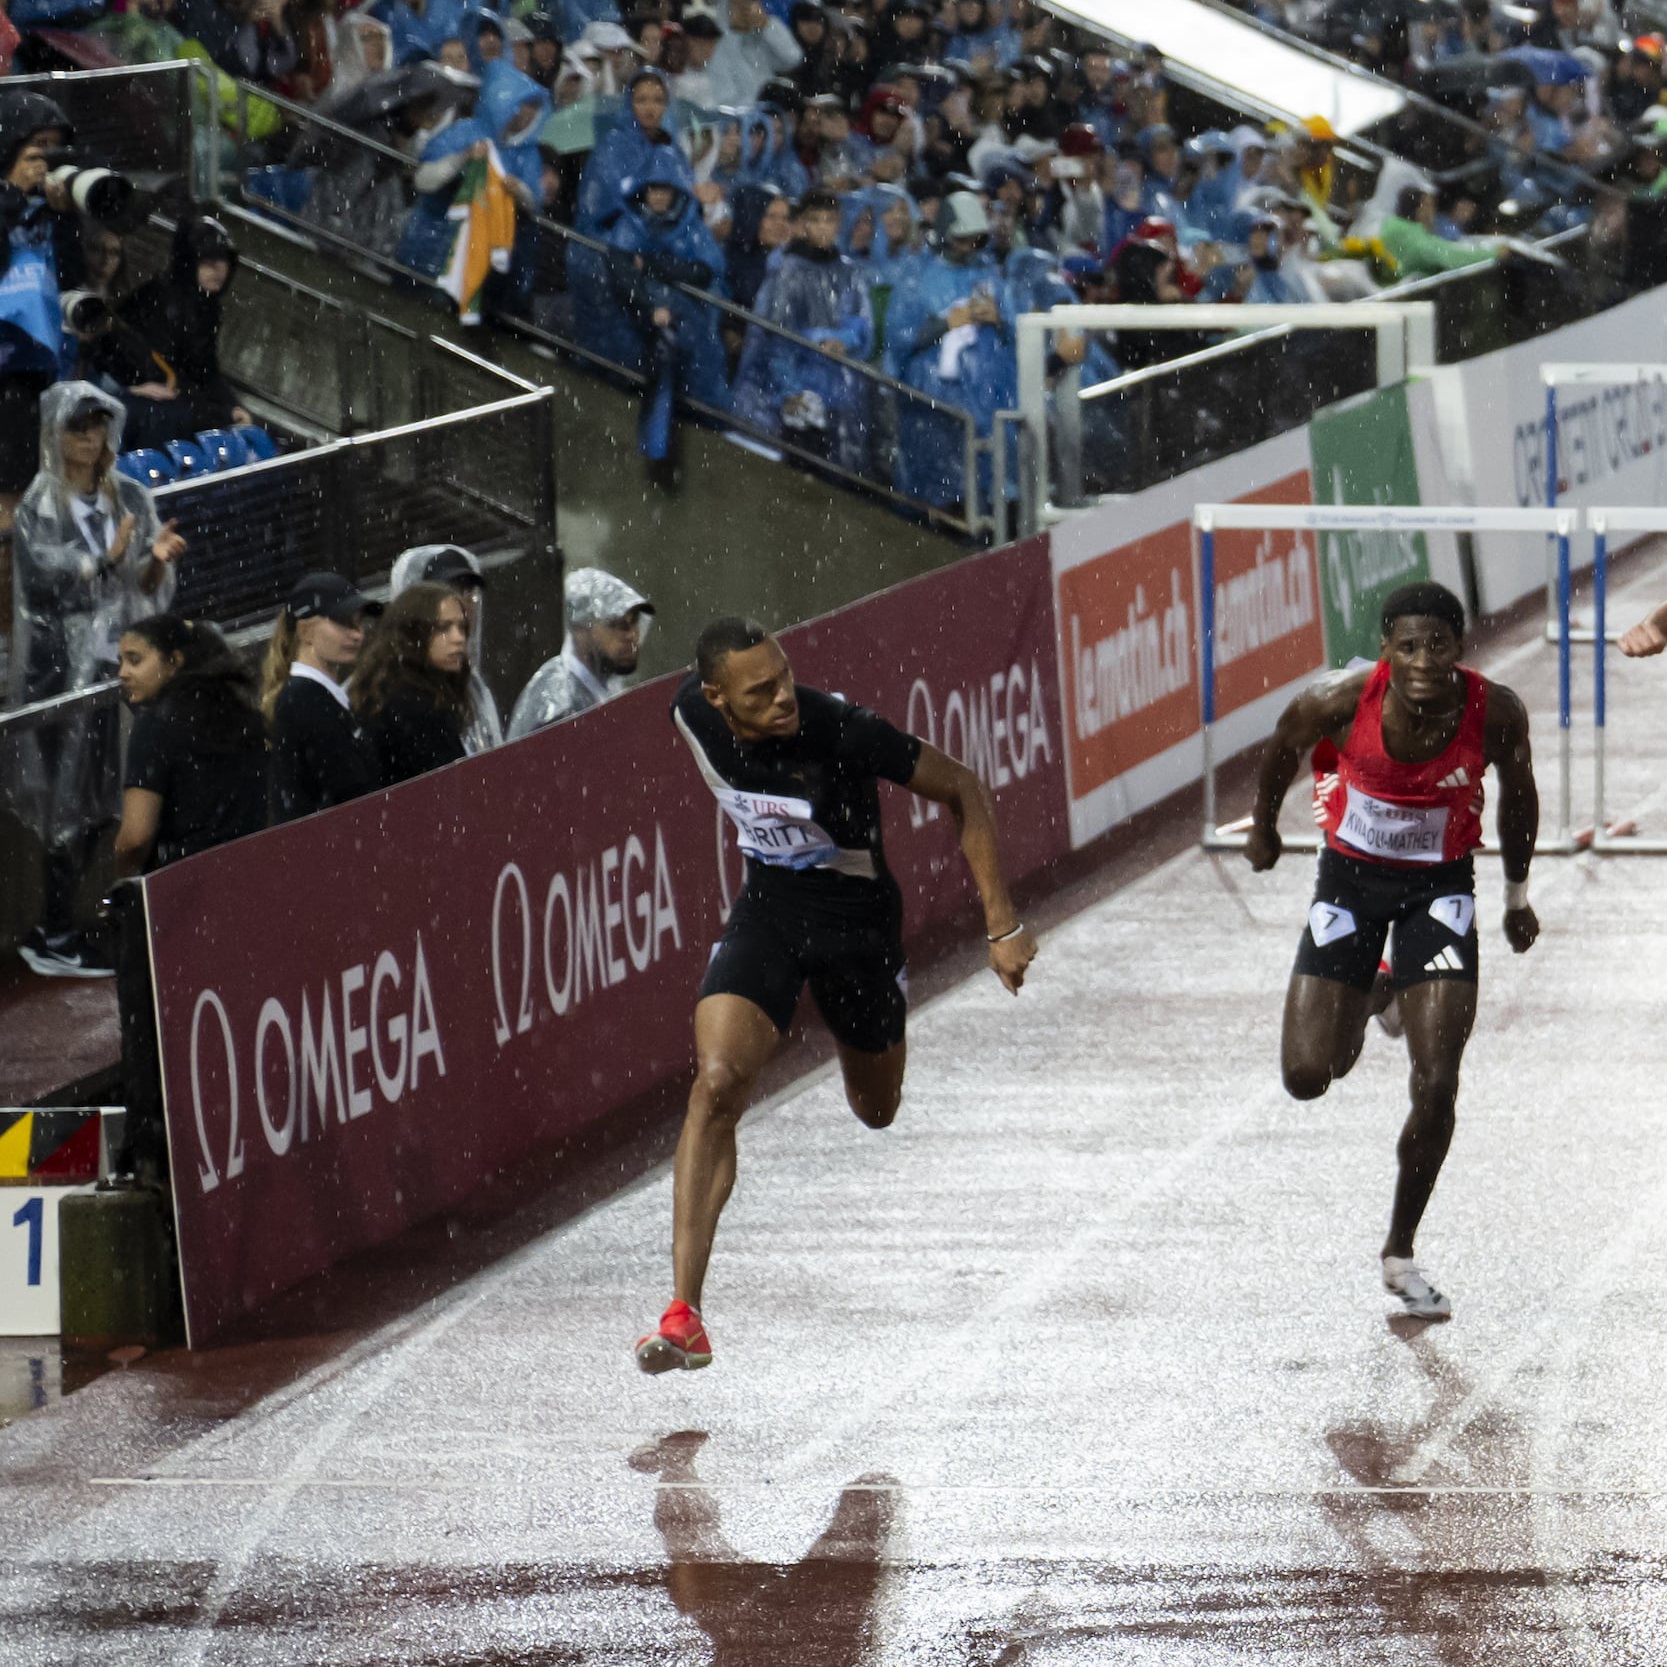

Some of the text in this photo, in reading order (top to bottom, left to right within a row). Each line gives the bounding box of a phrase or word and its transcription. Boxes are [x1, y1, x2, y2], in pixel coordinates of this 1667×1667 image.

[1212, 524, 1314, 673] ematin.ch
[944, 657, 1052, 790] OMEGA
[752, 798, 790, 816] UBS
[544, 821, 682, 1016] OMEGA
[1324, 910, 1339, 930] 7
[1449, 898, 1462, 919] 7
[255, 932, 447, 1156] OMEGA
[13, 1197, 43, 1286] 1
